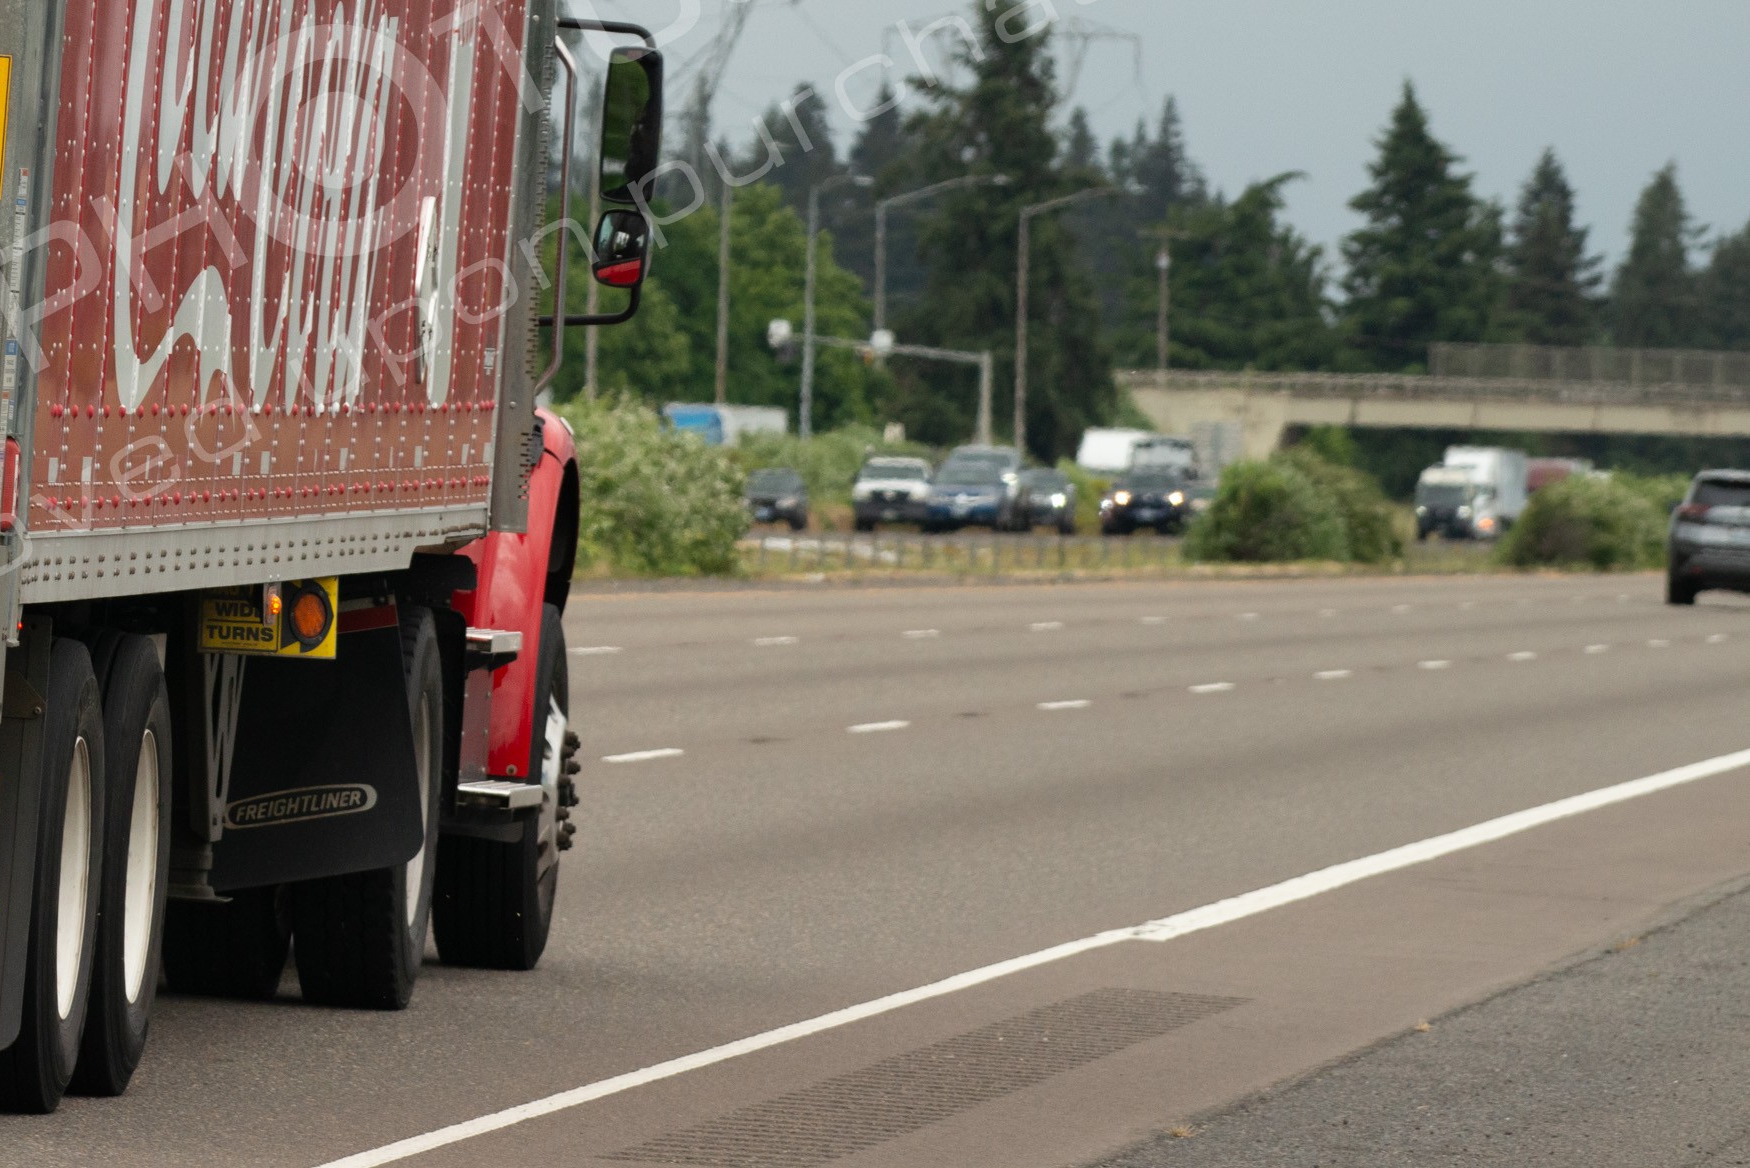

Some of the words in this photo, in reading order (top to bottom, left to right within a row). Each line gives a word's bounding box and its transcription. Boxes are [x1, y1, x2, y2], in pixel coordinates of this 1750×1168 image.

[215, 600, 261, 618] WID
[206, 624, 274, 642] TURNS
[235, 789, 362, 823] FREIGHTLINER
